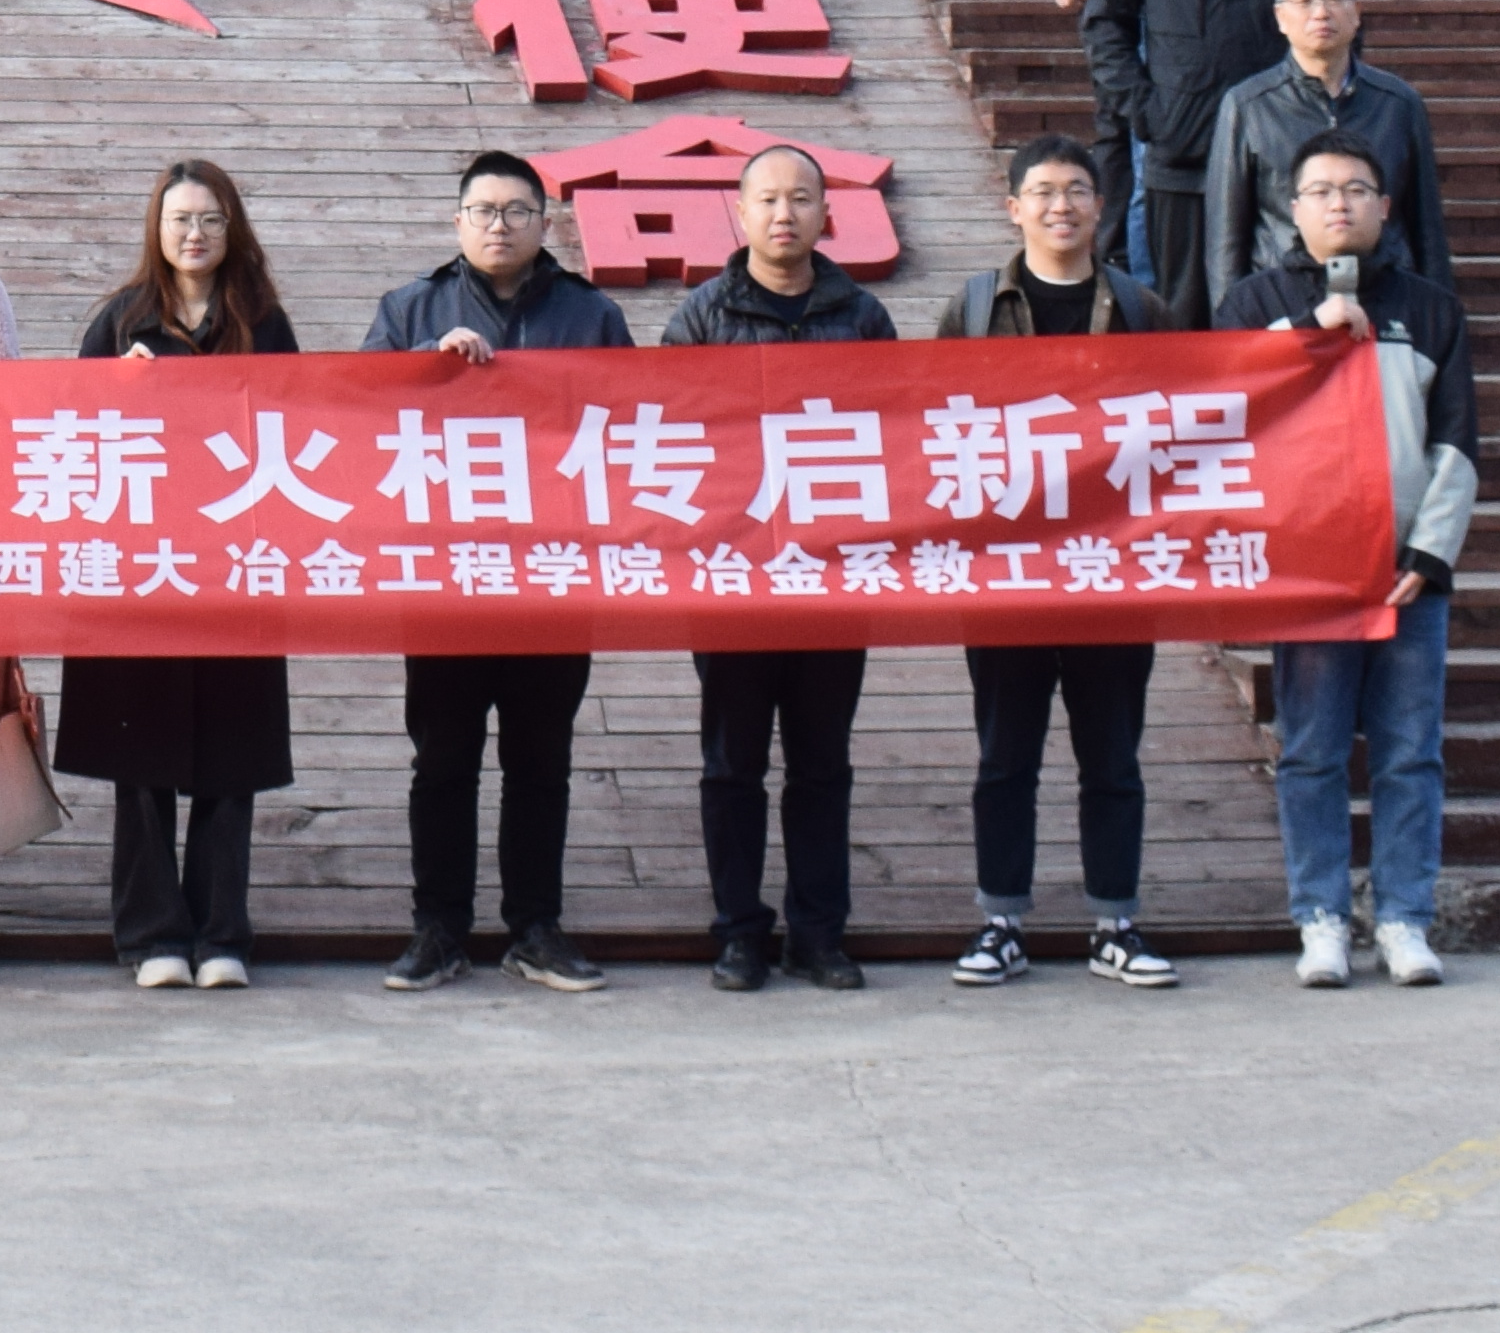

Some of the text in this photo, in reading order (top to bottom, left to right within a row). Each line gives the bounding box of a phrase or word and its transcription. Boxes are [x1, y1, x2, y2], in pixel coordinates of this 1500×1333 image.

[9, 391, 1266, 526] 薪火相传启新程
